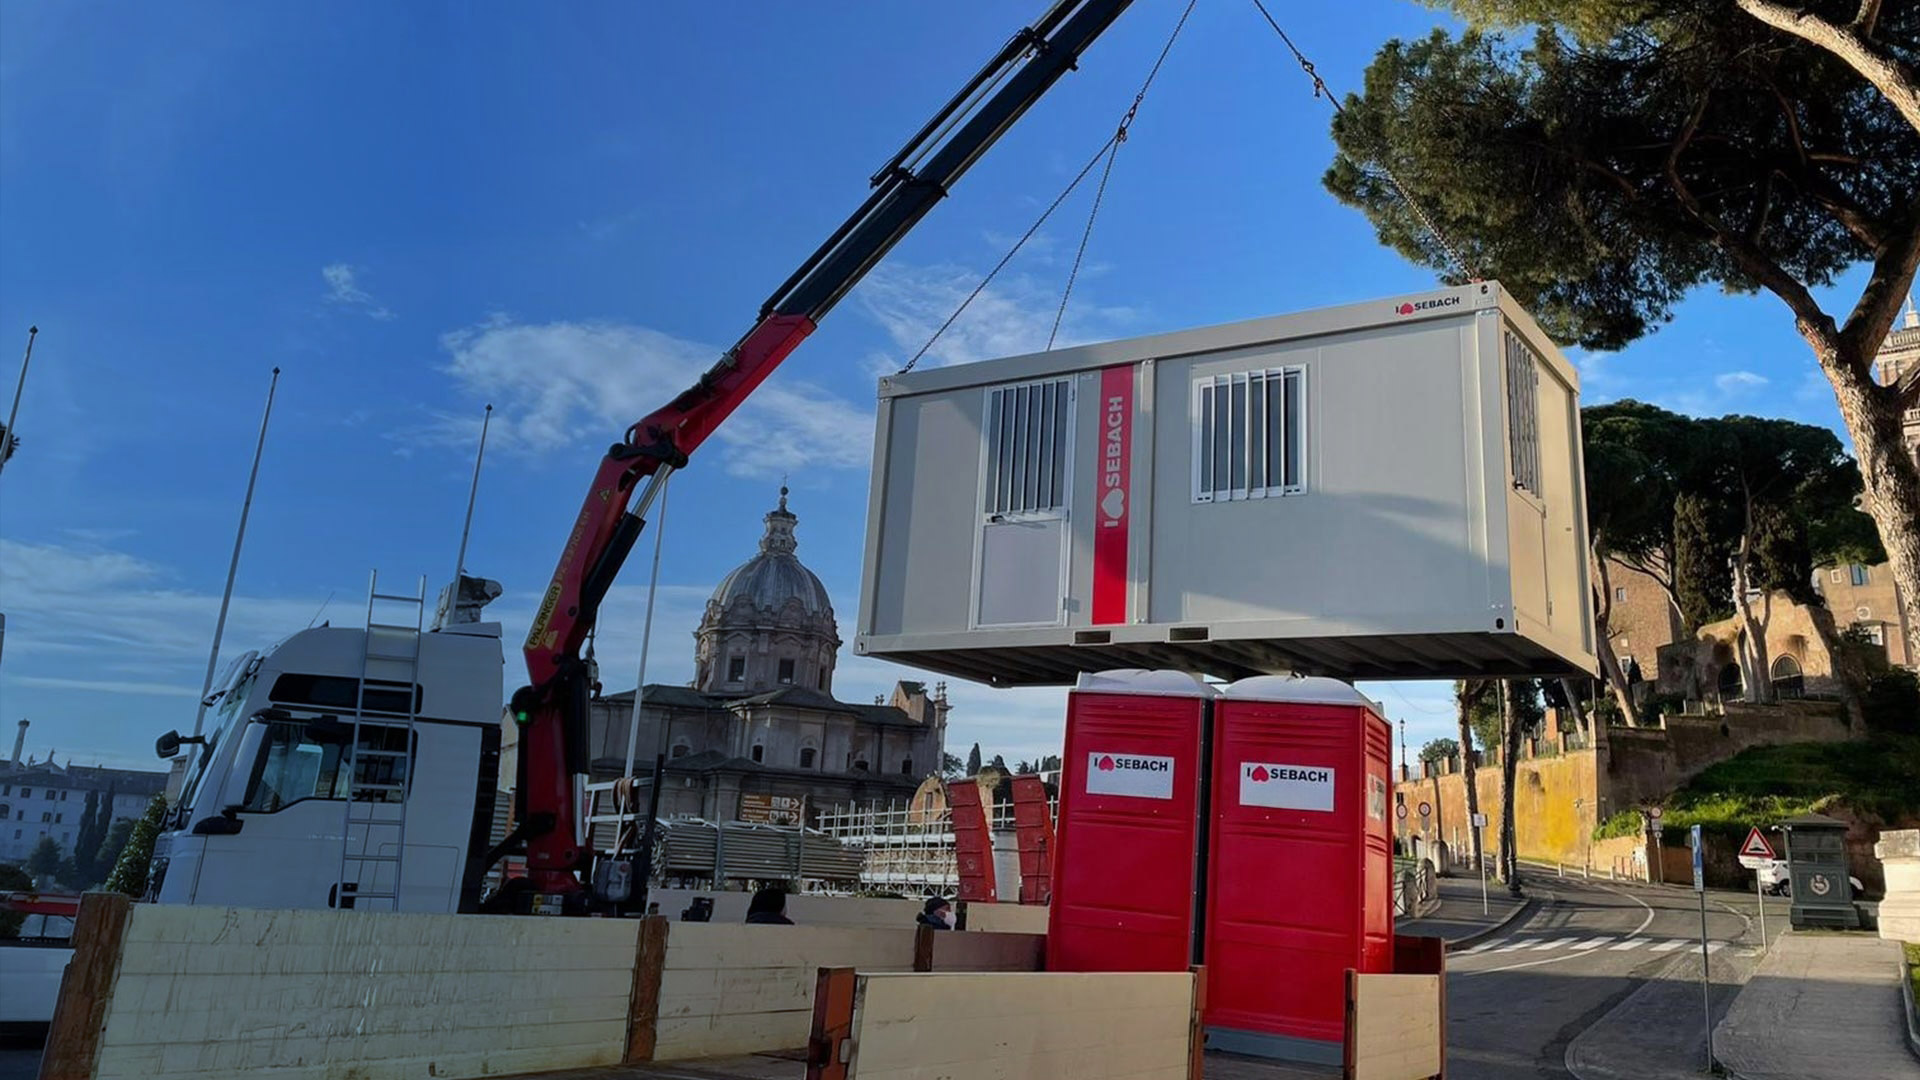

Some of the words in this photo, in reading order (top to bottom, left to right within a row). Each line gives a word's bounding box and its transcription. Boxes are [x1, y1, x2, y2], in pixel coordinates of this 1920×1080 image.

[1414, 297, 1460, 310] SEBACH
[1106, 396, 1123, 488] SEBACH
[1104, 520, 1119, 528] I
[1094, 757, 1098, 767] I
[1115, 758, 1168, 772] SEBACH
[1246, 767, 1251, 777] I
[1270, 768, 1328, 783] SEBACH
